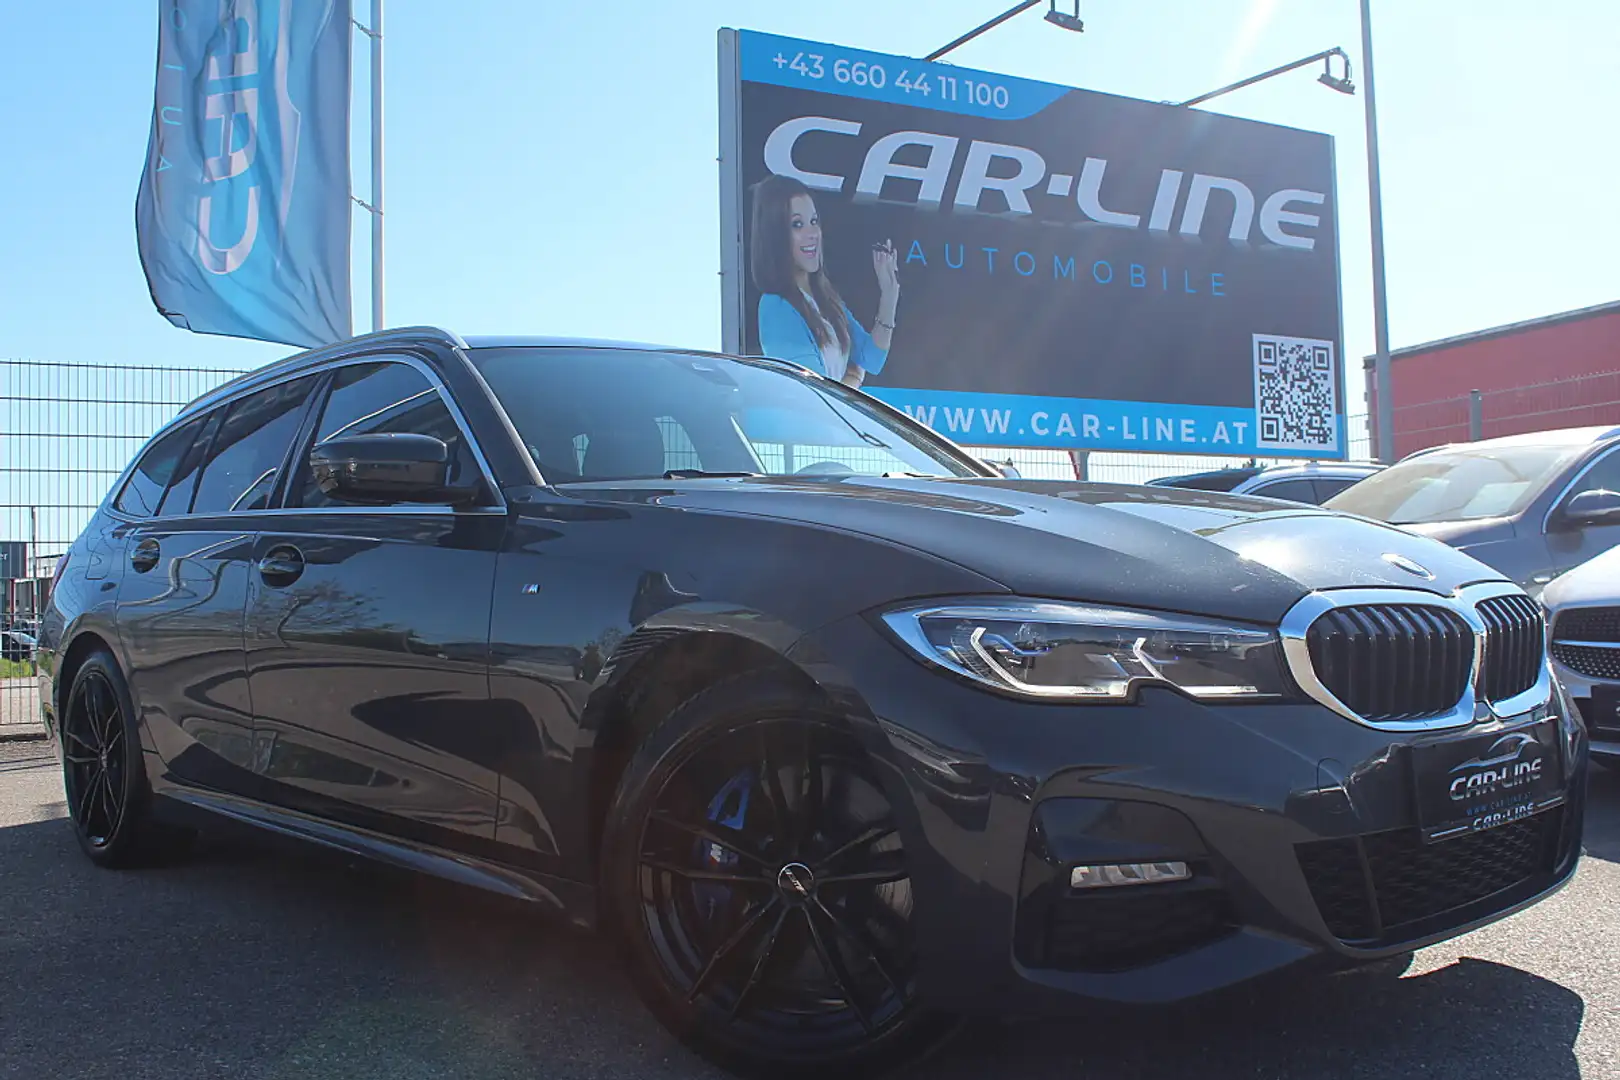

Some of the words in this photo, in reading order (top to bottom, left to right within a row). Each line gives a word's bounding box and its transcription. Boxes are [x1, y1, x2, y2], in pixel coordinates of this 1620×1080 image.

[772, 52, 825, 79] +43
[833, 59, 886, 89] 660
[895, 70, 931, 96] 44
[937, 75, 958, 101] 11
[965, 80, 1009, 109] 100
[906, 240, 1225, 296] AUTOMOBILE
[905, 404, 1248, 444] WWW.CAR-LINE.AT
